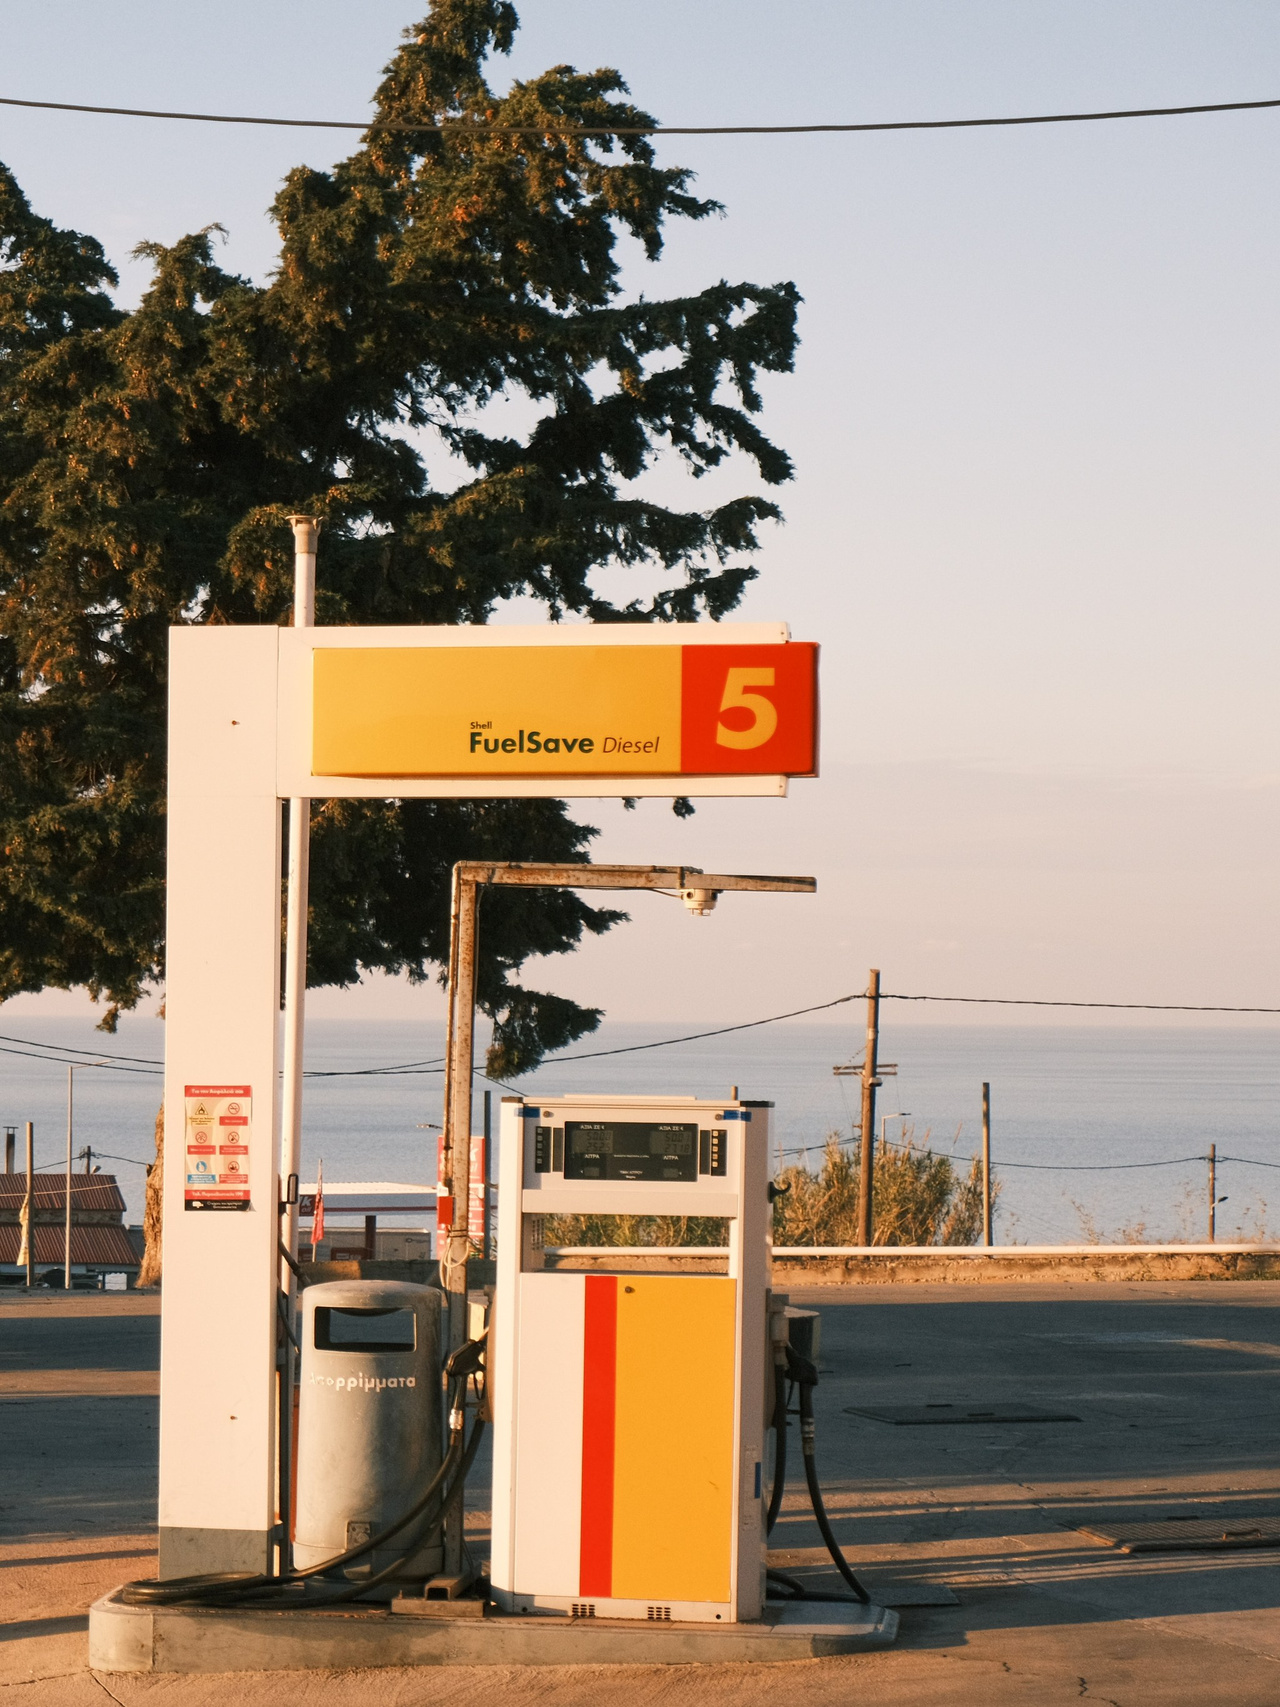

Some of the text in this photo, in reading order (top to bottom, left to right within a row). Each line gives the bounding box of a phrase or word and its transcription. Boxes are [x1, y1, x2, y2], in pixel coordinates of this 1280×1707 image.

[716, 667, 778, 750] 5
[470, 721, 492, 730] Shell
[470, 730, 660, 754] FuelSave Diesel
